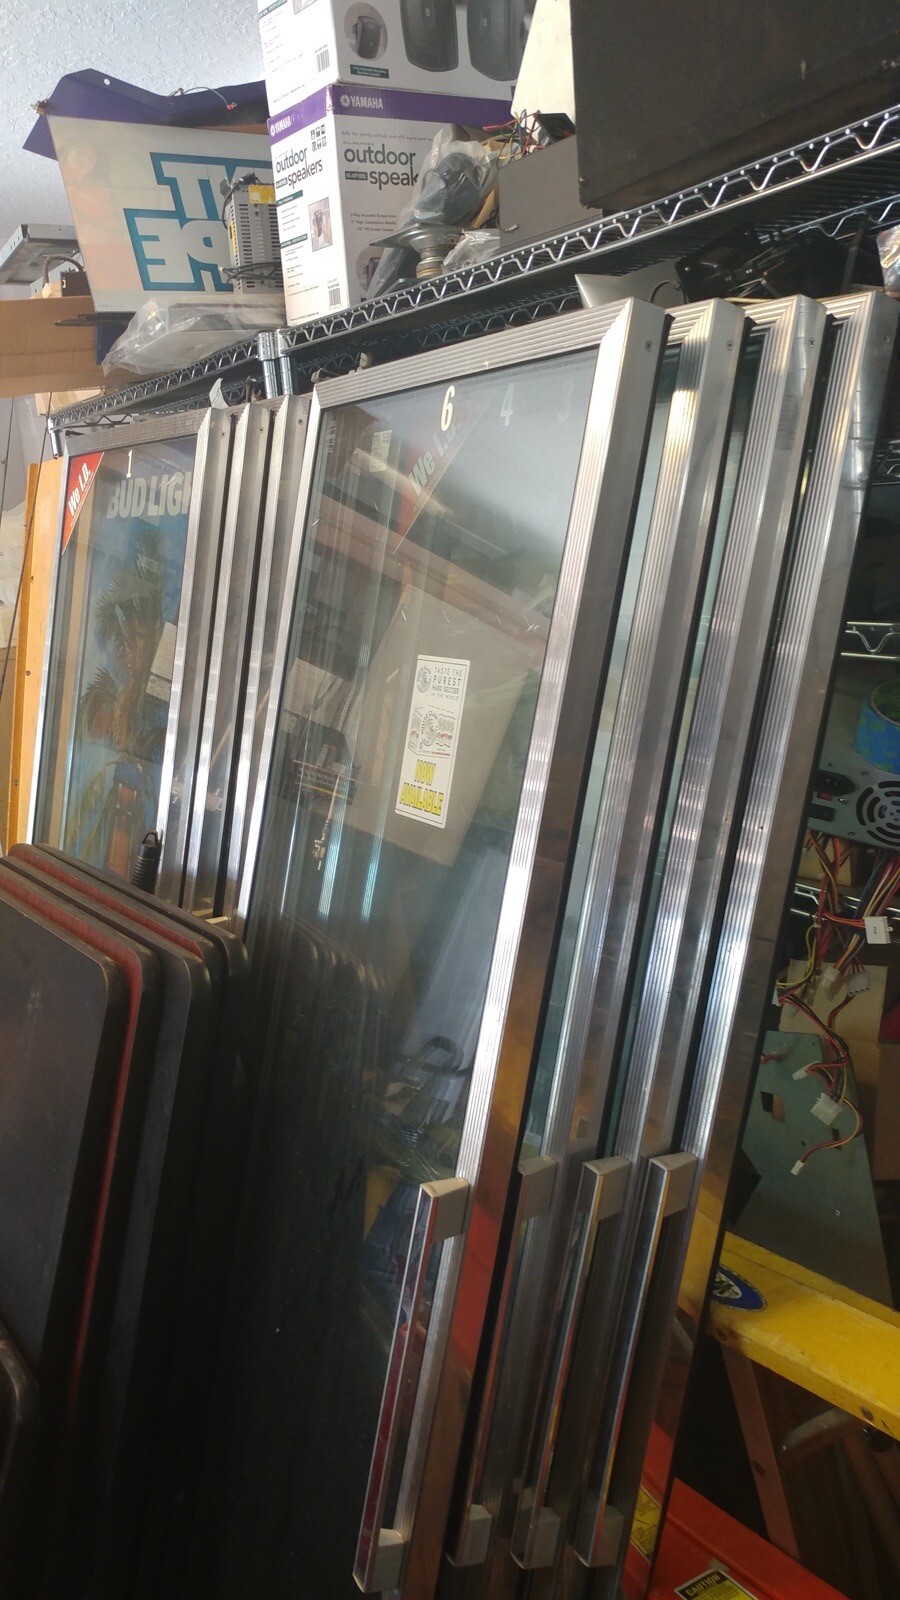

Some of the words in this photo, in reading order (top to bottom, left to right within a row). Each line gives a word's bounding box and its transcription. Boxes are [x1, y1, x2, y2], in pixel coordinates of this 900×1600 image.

[350, 94, 384, 110] YAMAHA
[273, 115, 292, 134] YAMAHA
[275, 147, 308, 174] outdoor
[344, 143, 416, 166] outdoor
[287, 159, 324, 190] speakers
[440, 385, 456, 432] 6
[499, 382, 515, 427] 4
[126, 449, 133, 478] 1
[407, 450, 436, 496] We
[67, 486, 81, 517] We
[78, 461, 92, 493] I.D.
[106, 477, 147, 519] BUD
[432, 674, 462, 687] PUREST
[433, 666, 450, 676] TASTE
[452, 668, 463, 677] THE
[414, 759, 436, 786] NOW
[399, 782, 444, 816] AVAILABLE
[685, 1573, 722, 1597] CAUTION
